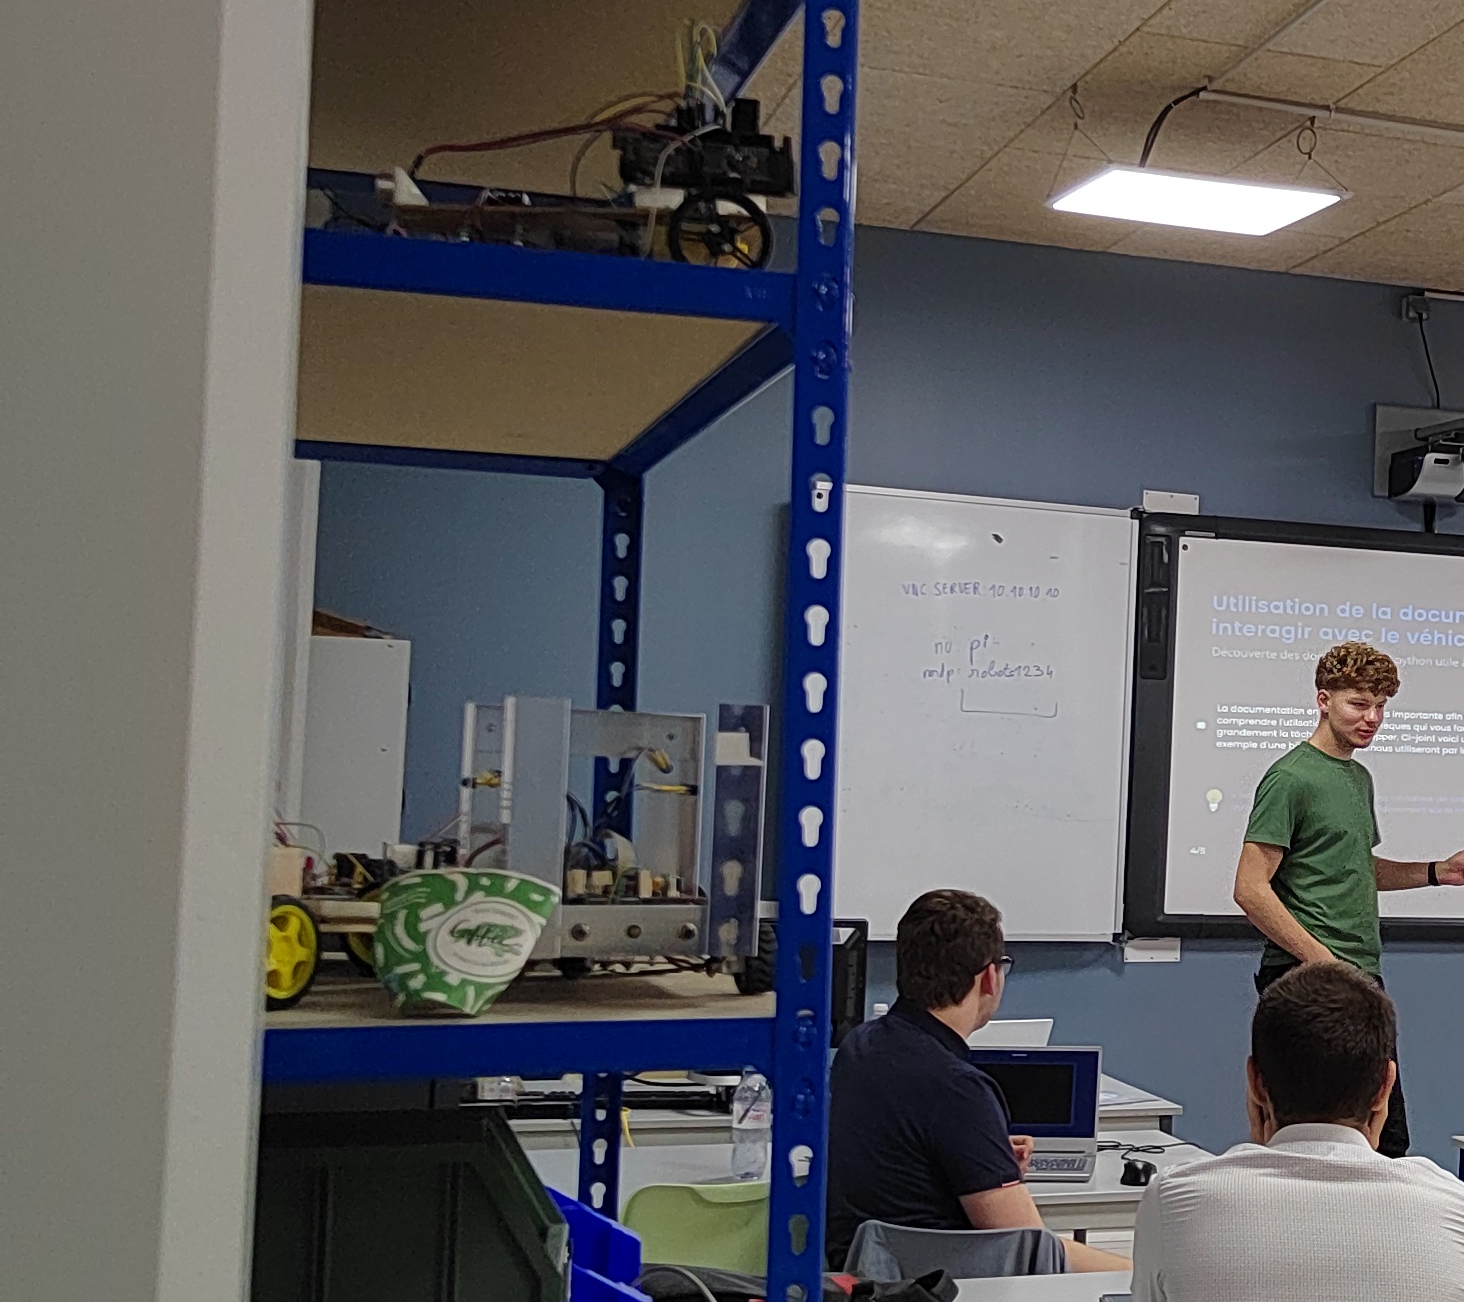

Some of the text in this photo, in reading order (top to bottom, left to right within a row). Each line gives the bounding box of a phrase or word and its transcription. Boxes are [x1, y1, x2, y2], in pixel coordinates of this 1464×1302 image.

[1212, 595, 1329, 617] Utilisation
[1336, 601, 1364, 618] de
[1372, 603, 1392, 620] la
[1211, 618, 1312, 644] interagir
[1319, 627, 1373, 641] avec
[1381, 627, 1400, 643] le
[1212, 647, 1277, 659] Découverte
[1280, 650, 1300, 661] des
[1435, 655, 1459, 667] utile
[1217, 704, 1228, 713] La
[1230, 705, 1305, 715] documentation
[1392, 711, 1443, 720] importante
[1445, 713, 1463, 721] afin
[1217, 717, 1278, 728] comprendre
[1413, 723, 1428, 732] qui
[1430, 725, 1451, 733] vous
[1216, 728, 1312, 738] grandement la tâch
[1401, 733, 1436, 743] Ci-joint
[1438, 735, 1459, 743] voici
[1216, 740, 1257, 750] exemple
[1259, 740, 1287, 750] d'une
[1371, 745, 1393, 753] nous
[1395, 744, 1440, 754] utiliseront
[1442, 746, 1458, 756] par
